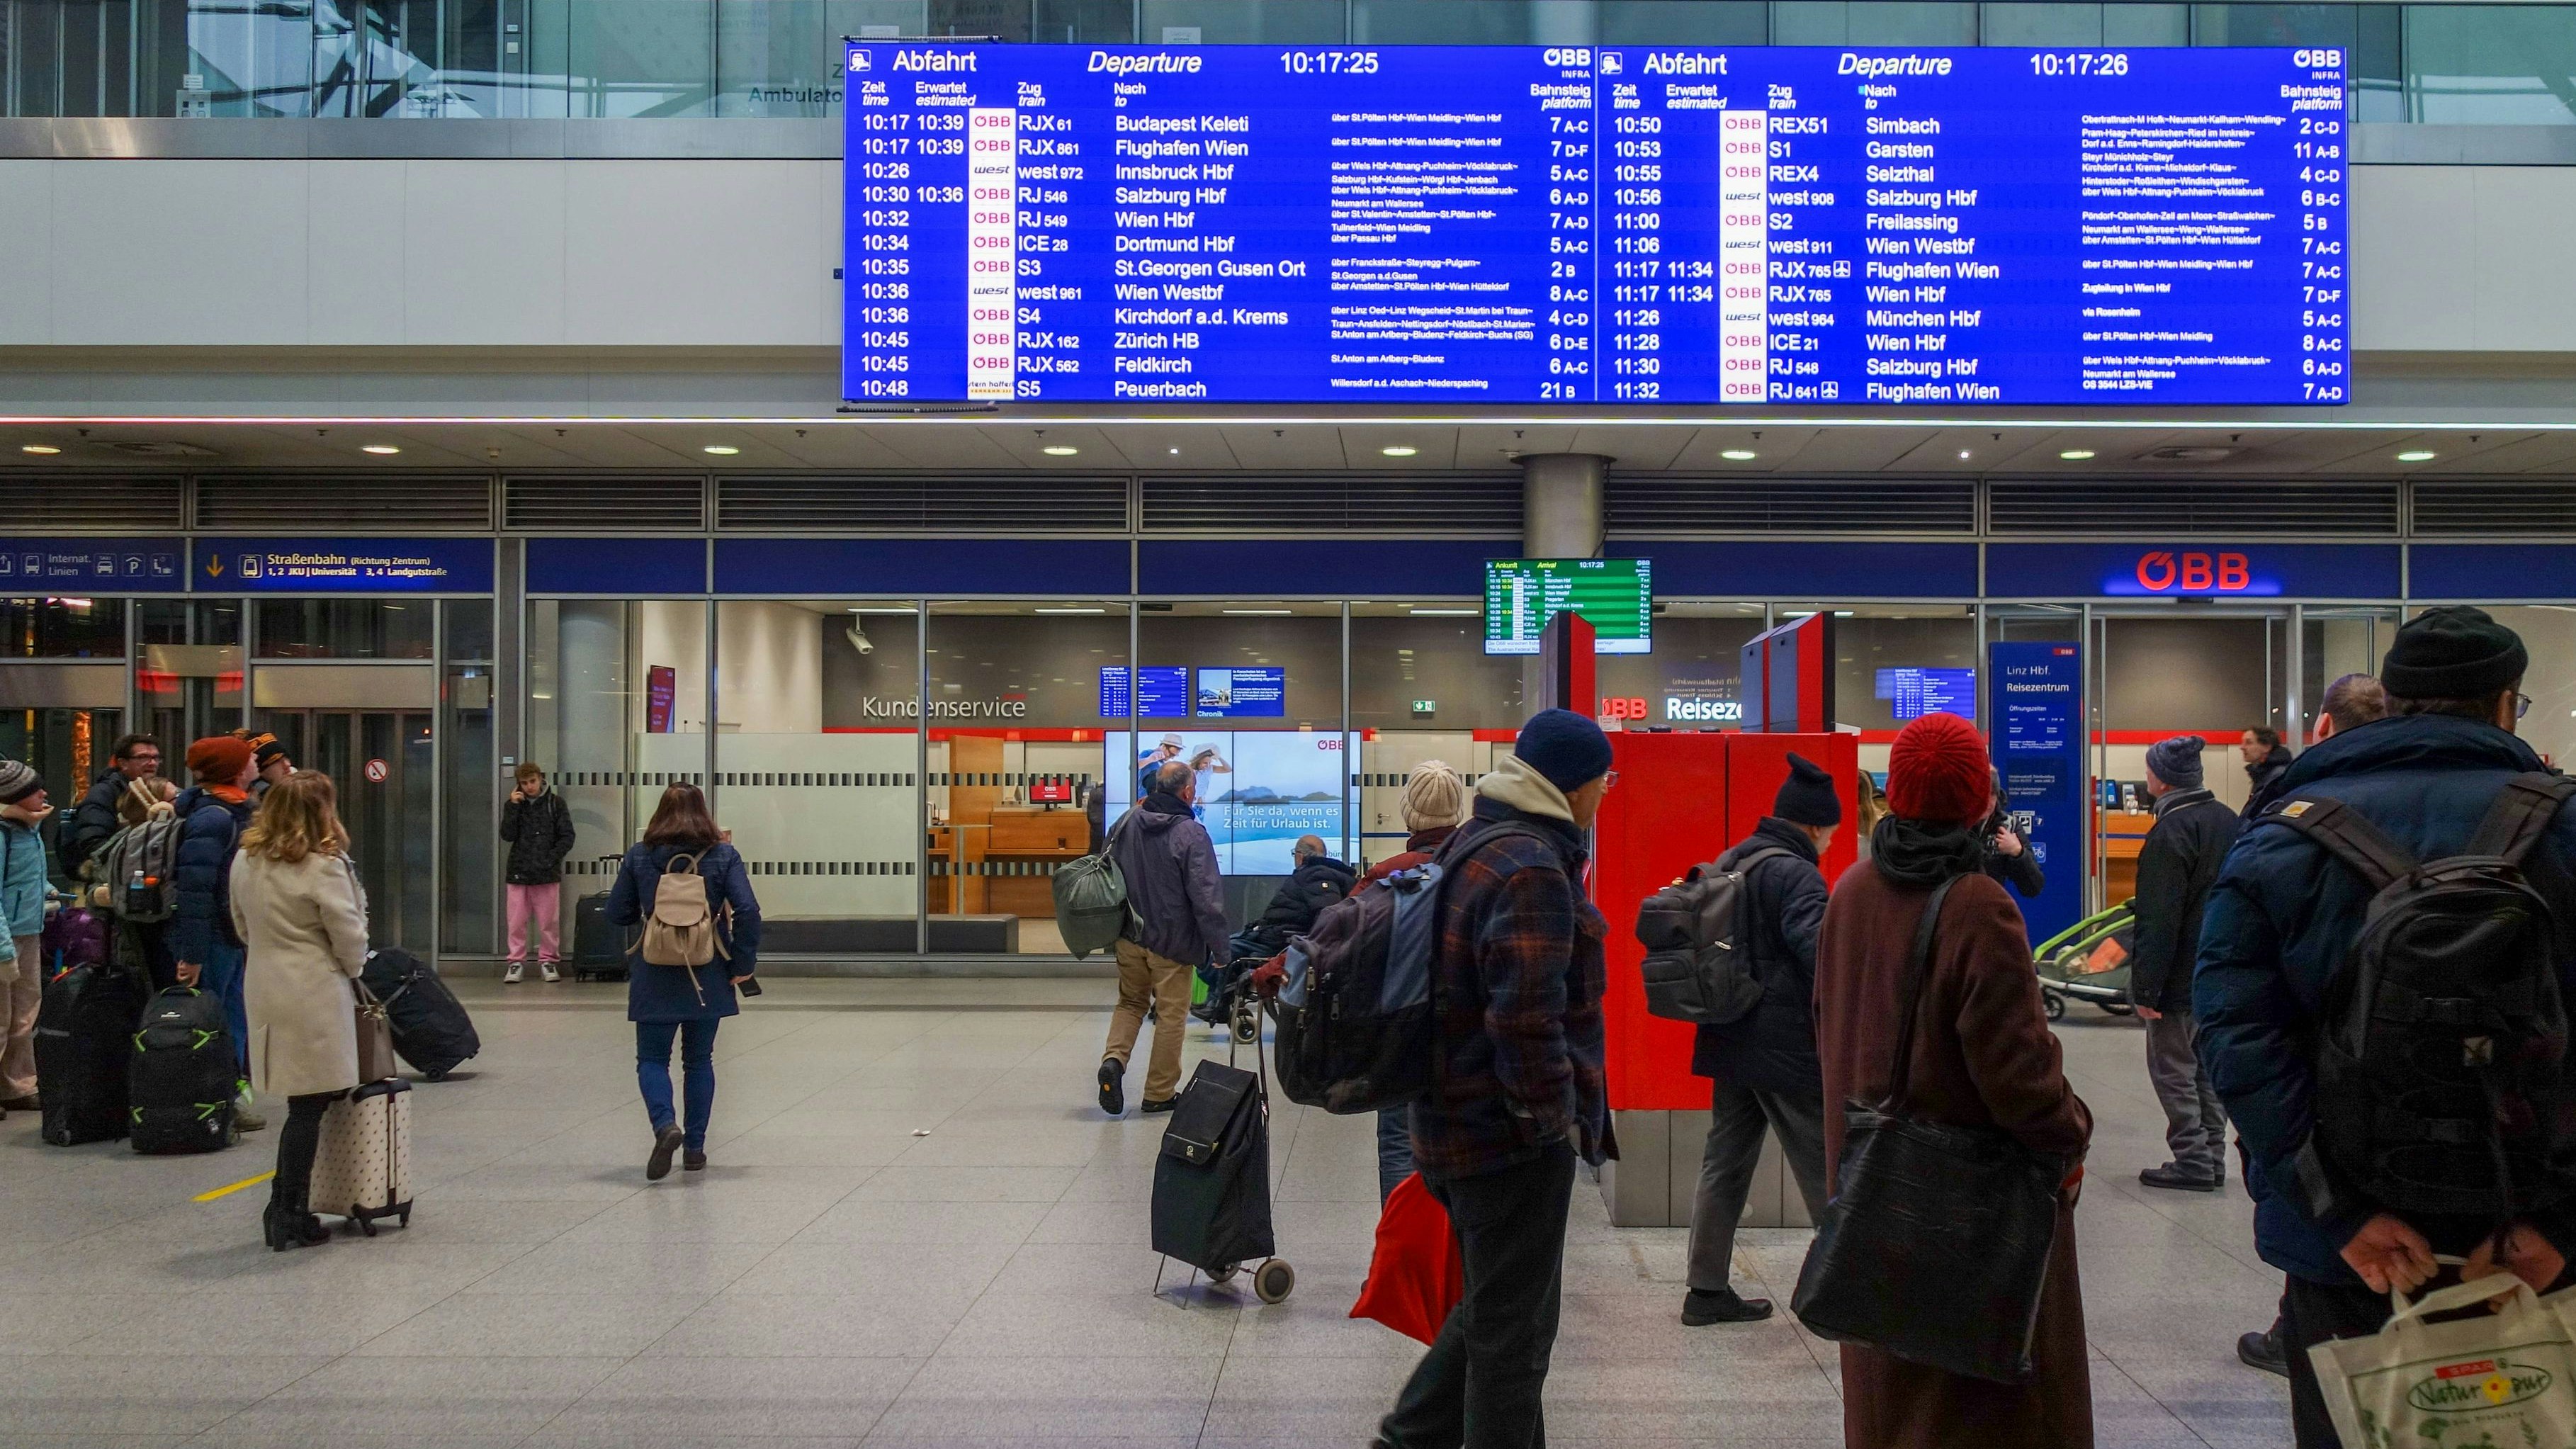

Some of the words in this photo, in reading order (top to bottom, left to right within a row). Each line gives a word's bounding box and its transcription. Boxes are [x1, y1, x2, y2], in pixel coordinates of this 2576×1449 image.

[893, 50, 976, 72] Abfahrt
[1088, 51, 1202, 77] Departure
[1280, 52, 1379, 74] 10:17:25
[1544, 48, 1591, 67] ÖBB
[1644, 52, 1727, 74] Abfahrt
[2030, 54, 2129, 76] 10:17:26
[2293, 50, 2342, 67] ÖBB
[1838, 53, 1953, 79] Departure
[1561, 70, 1591, 79] INFRA
[2312, 72, 2341, 80] INFRA
[748, 87, 843, 103] Ambulato
[862, 82, 886, 94] Zeit
[915, 82, 967, 94] Erwartet
[1017, 82, 1041, 96] Zug
[1114, 82, 1146, 94] Nach
[1530, 84, 1591, 97] Bahnsteig
[2281, 85, 2341, 99] Bahnsteig
[862, 94, 890, 106] time
[915, 94, 976, 107] estimated
[1018, 94, 1046, 107] train
[1114, 95, 1128, 107] to
[1541, 97, 1592, 111] platform
[863, 114, 910, 130] 10:17
[917, 115, 964, 131] 10:39
[974, 115, 1010, 128] ÖBB
[1019, 115, 1055, 132] RJX
[1056, 119, 1072, 131] 61
[1116, 115, 1197, 135] Budapest
[1202, 116, 1249, 133] Keleti
[1551, 117, 1561, 133] 7
[1564, 120, 1588, 133] A-C
[1615, 117, 1662, 134] 10:50
[1770, 117, 1828, 134] REX51
[1866, 117, 1941, 135] Simbach
[2300, 118, 2312, 135] 2
[2315, 122, 2340, 135] C-D
[863, 163, 910, 179] 10:26
[974, 165, 1010, 174] west
[1017, 164, 1058, 179] west
[1060, 168, 1083, 180] 972
[1116, 164, 1199, 180] Innsbruck
[1203, 164, 1235, 180] Hbf
[1550, 165, 1562, 181] 5
[1564, 169, 1588, 181] A-C
[1116, 236, 1199, 252] Dortmund
[1204, 236, 1236, 252] Hbf
[1331, 234, 1350, 242] über
[862, 259, 910, 276] 10:35
[973, 259, 1010, 272] ÖBB
[1018, 259, 1041, 276] S3
[1115, 259, 1212, 280] St.Georgen
[1217, 260, 1274, 277] Gusen
[1278, 260, 1306, 277] Ort
[1552, 261, 1563, 278] 2
[1566, 265, 1576, 278] B
[2156, 283, 2171, 293] Hbf
[1615, 310, 1660, 326] 11:26
[1725, 312, 1761, 321] west
[1768, 311, 1809, 327] west
[1811, 314, 1835, 327] 964
[1866, 310, 1945, 327] München
[1950, 310, 1982, 327] Hbf
[2303, 310, 2315, 327] 5
[2316, 314, 2341, 327] A-C
[1114, 332, 1168, 349] Zürich
[1173, 333, 1200, 349] HB
[862, 380, 909, 397] 10:48
[1017, 380, 1041, 398] S5
[1114, 381, 1207, 398] Peuerbach
[1540, 382, 1560, 398] 21
[1566, 386, 1576, 398] B
[1615, 383, 1660, 399] 11:32
[1725, 383, 1761, 395] ÖBB
[1770, 383, 1793, 399] RJ
[1795, 386, 1817, 399] 641
[1867, 383, 1952, 403] Flughafen
[1955, 383, 2000, 400] Wien
[2303, 383, 2315, 400] 7
[2317, 387, 2342, 400] A-D
[48, 554, 91, 564] Internat.
[267, 553, 346, 565] Straßenbahn
[350, 557, 390, 566] (Richtung
[392, 557, 431, 566] Zentrum)
[48, 567, 79, 576] Linien
[278, 568, 284, 576] 2
[377, 568, 384, 576] 4
[387, 568, 448, 577] Landgutstraße
[2136, 551, 2250, 591] ÖBB
[2007, 665, 2027, 675] Linz
[2006, 682, 2069, 692] Reisezentrum
[862, 696, 1026, 718] Kundenservice
[2009, 704, 2047, 713] Öffnungszeiten
[1224, 806, 1244, 816] Für
[1248, 806, 1265, 816] Sie
[1268, 806, 1286, 817] da,
[1224, 818, 1247, 828] Zeit
[1251, 818, 1267, 828] für
[1271, 818, 1310, 828] Urlaub
[1314, 818, 1331, 828] ist.
[2417, 1379, 2480, 1406] Natur
[2510, 1375, 2547, 1396] pur
